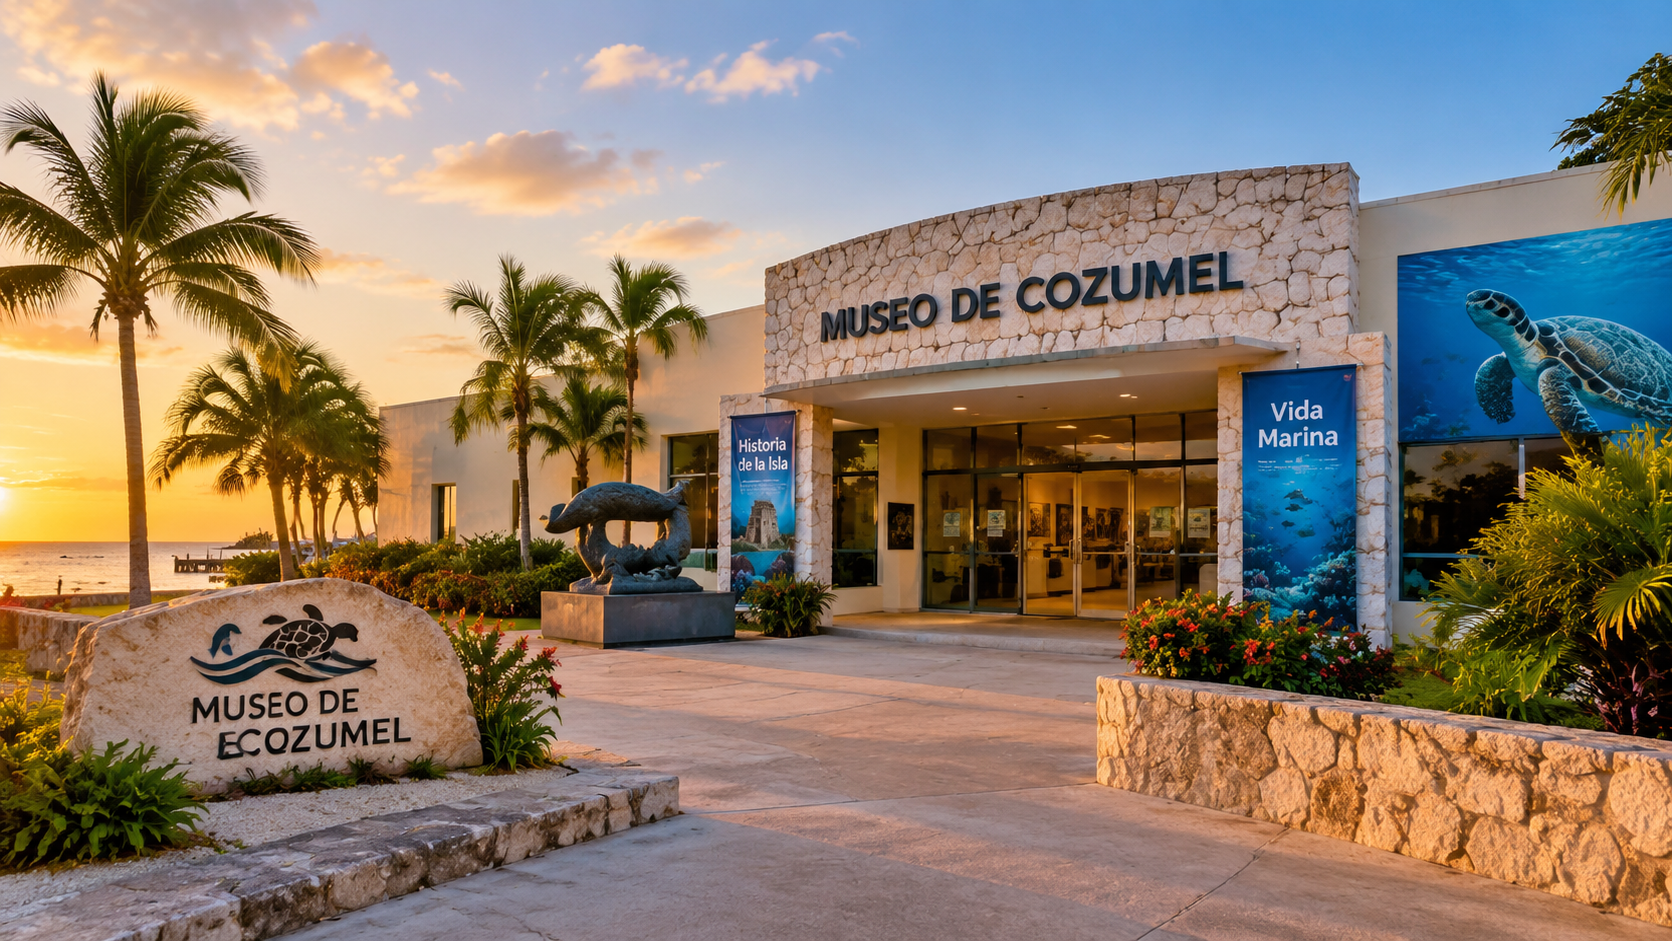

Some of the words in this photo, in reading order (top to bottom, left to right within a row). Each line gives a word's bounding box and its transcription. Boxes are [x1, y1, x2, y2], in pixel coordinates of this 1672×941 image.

[820, 293, 938, 343] MUSEO
[951, 283, 1000, 323] DE
[1016, 251, 1244, 313] COZUMEL
[1270, 399, 1323, 422] Vida
[738, 437, 787, 453] Historia
[1258, 426, 1338, 448] Marina
[738, 457, 752, 472] de
[755, 456, 765, 471] la
[769, 455, 788, 471] Isla
[191, 691, 308, 724] MUSEO
[319, 688, 359, 714] DE
